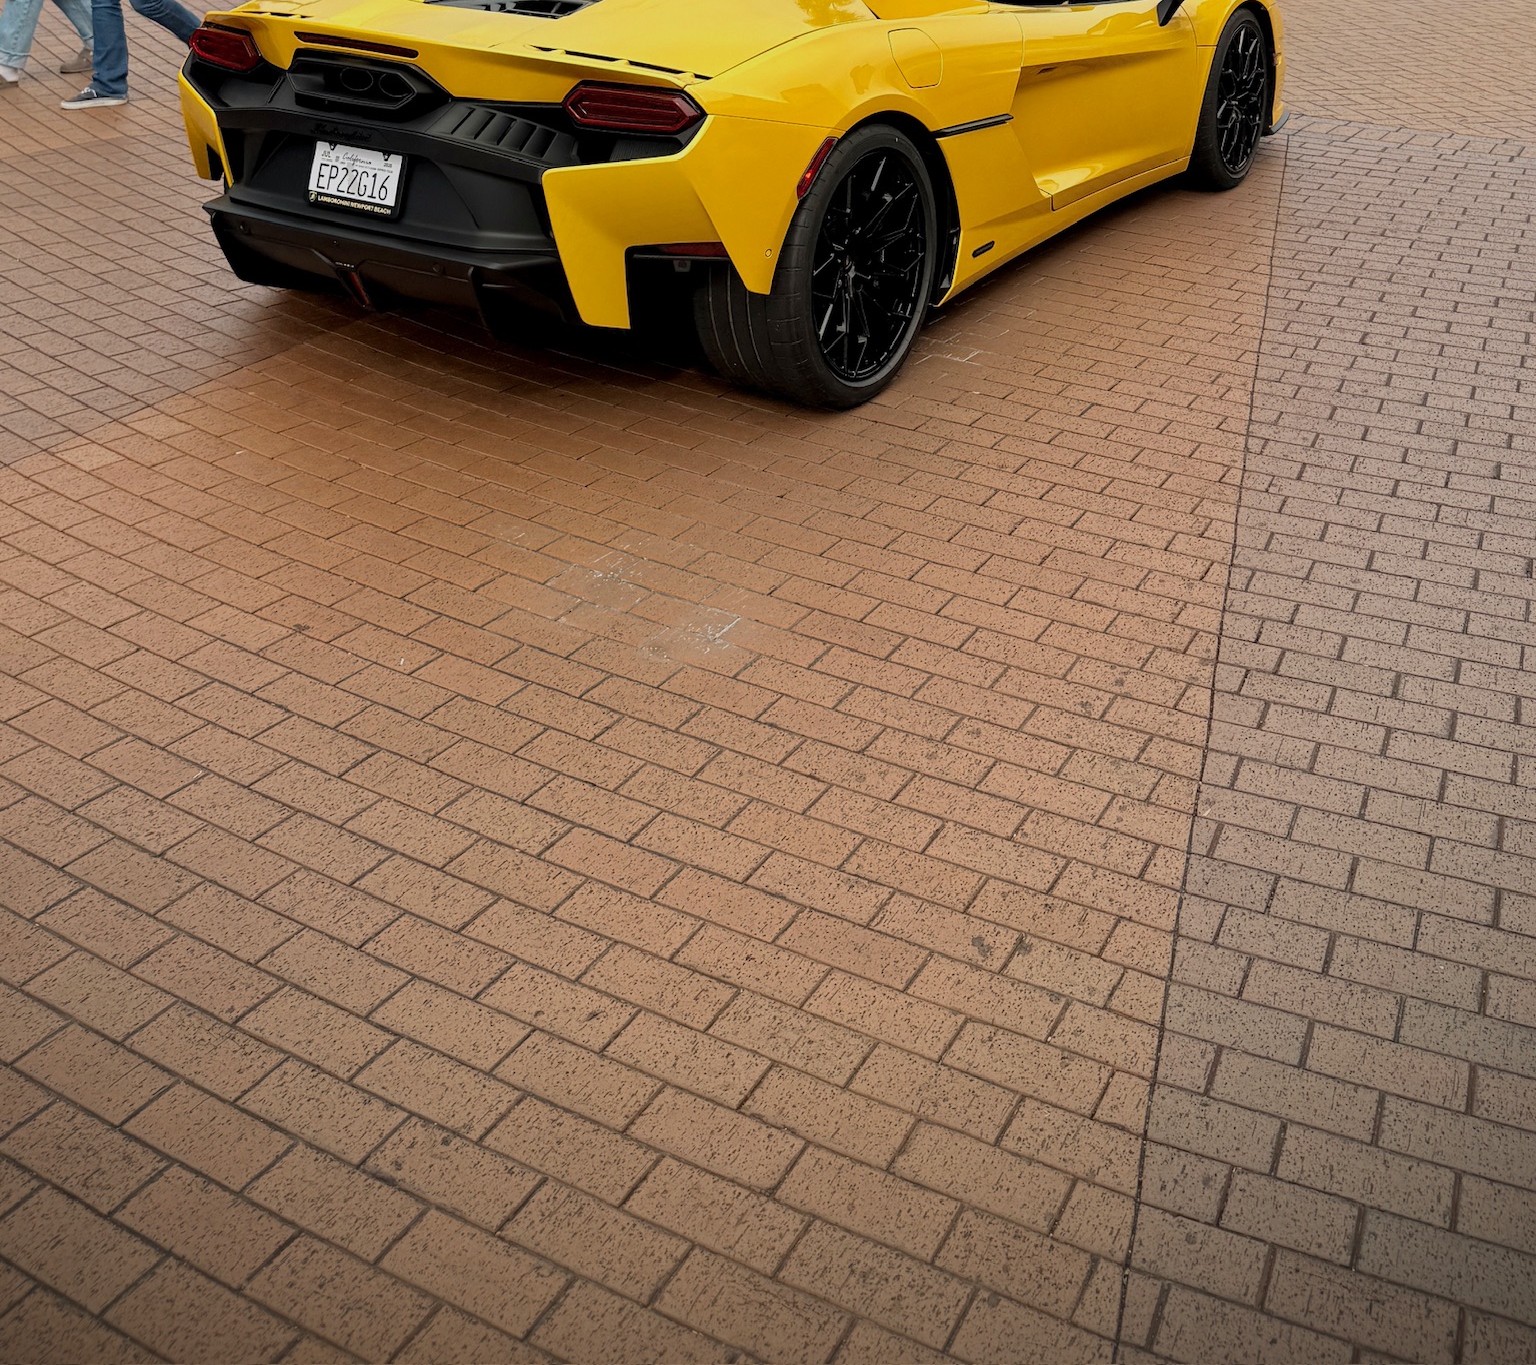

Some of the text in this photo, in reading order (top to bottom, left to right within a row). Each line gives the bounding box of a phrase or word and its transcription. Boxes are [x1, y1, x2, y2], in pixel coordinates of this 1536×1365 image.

[342, 151, 372, 166] California
[316, 163, 390, 201] EP22G16
[317, 195, 392, 215] LAMBORGHINI NEWPORT BEACH
